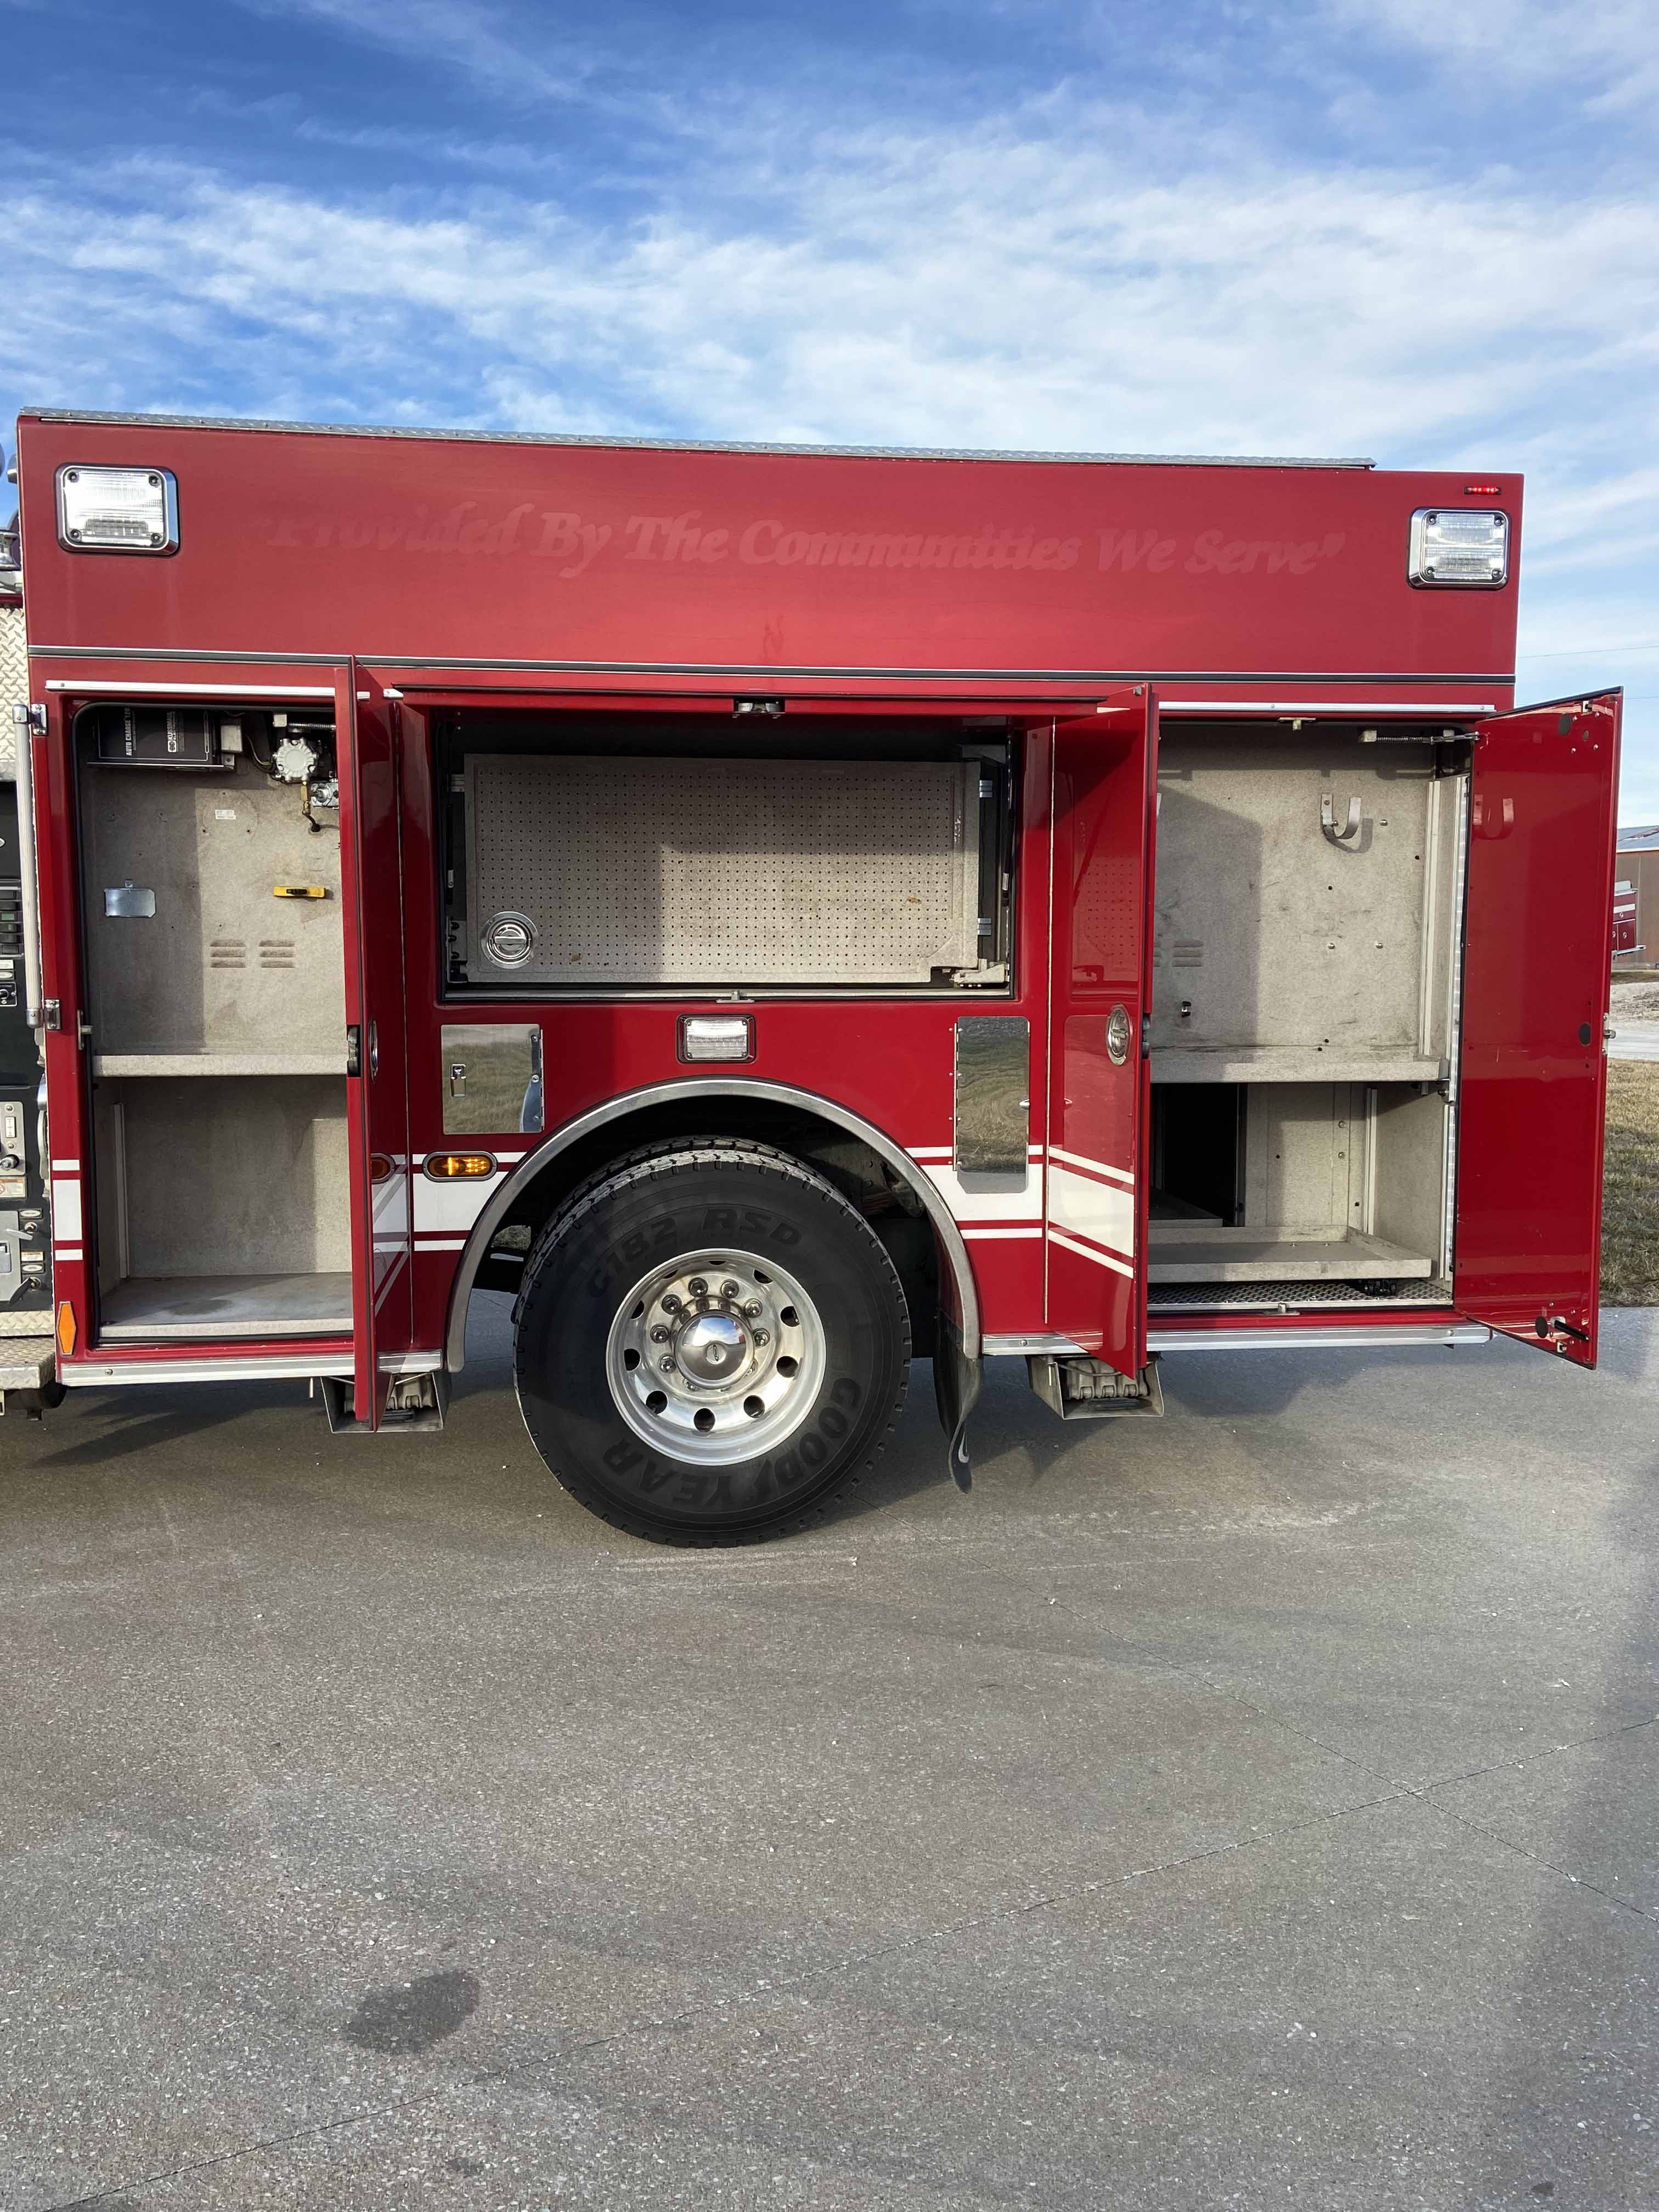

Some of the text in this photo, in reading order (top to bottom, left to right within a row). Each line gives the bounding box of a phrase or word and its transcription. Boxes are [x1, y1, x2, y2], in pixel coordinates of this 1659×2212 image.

[529, 512, 613, 579] By
[625, 510, 730, 564] The
[738, 519, 1082, 571] Communities
[1095, 528, 1177, 572] We
[702, 1207, 803, 1246] RSD
